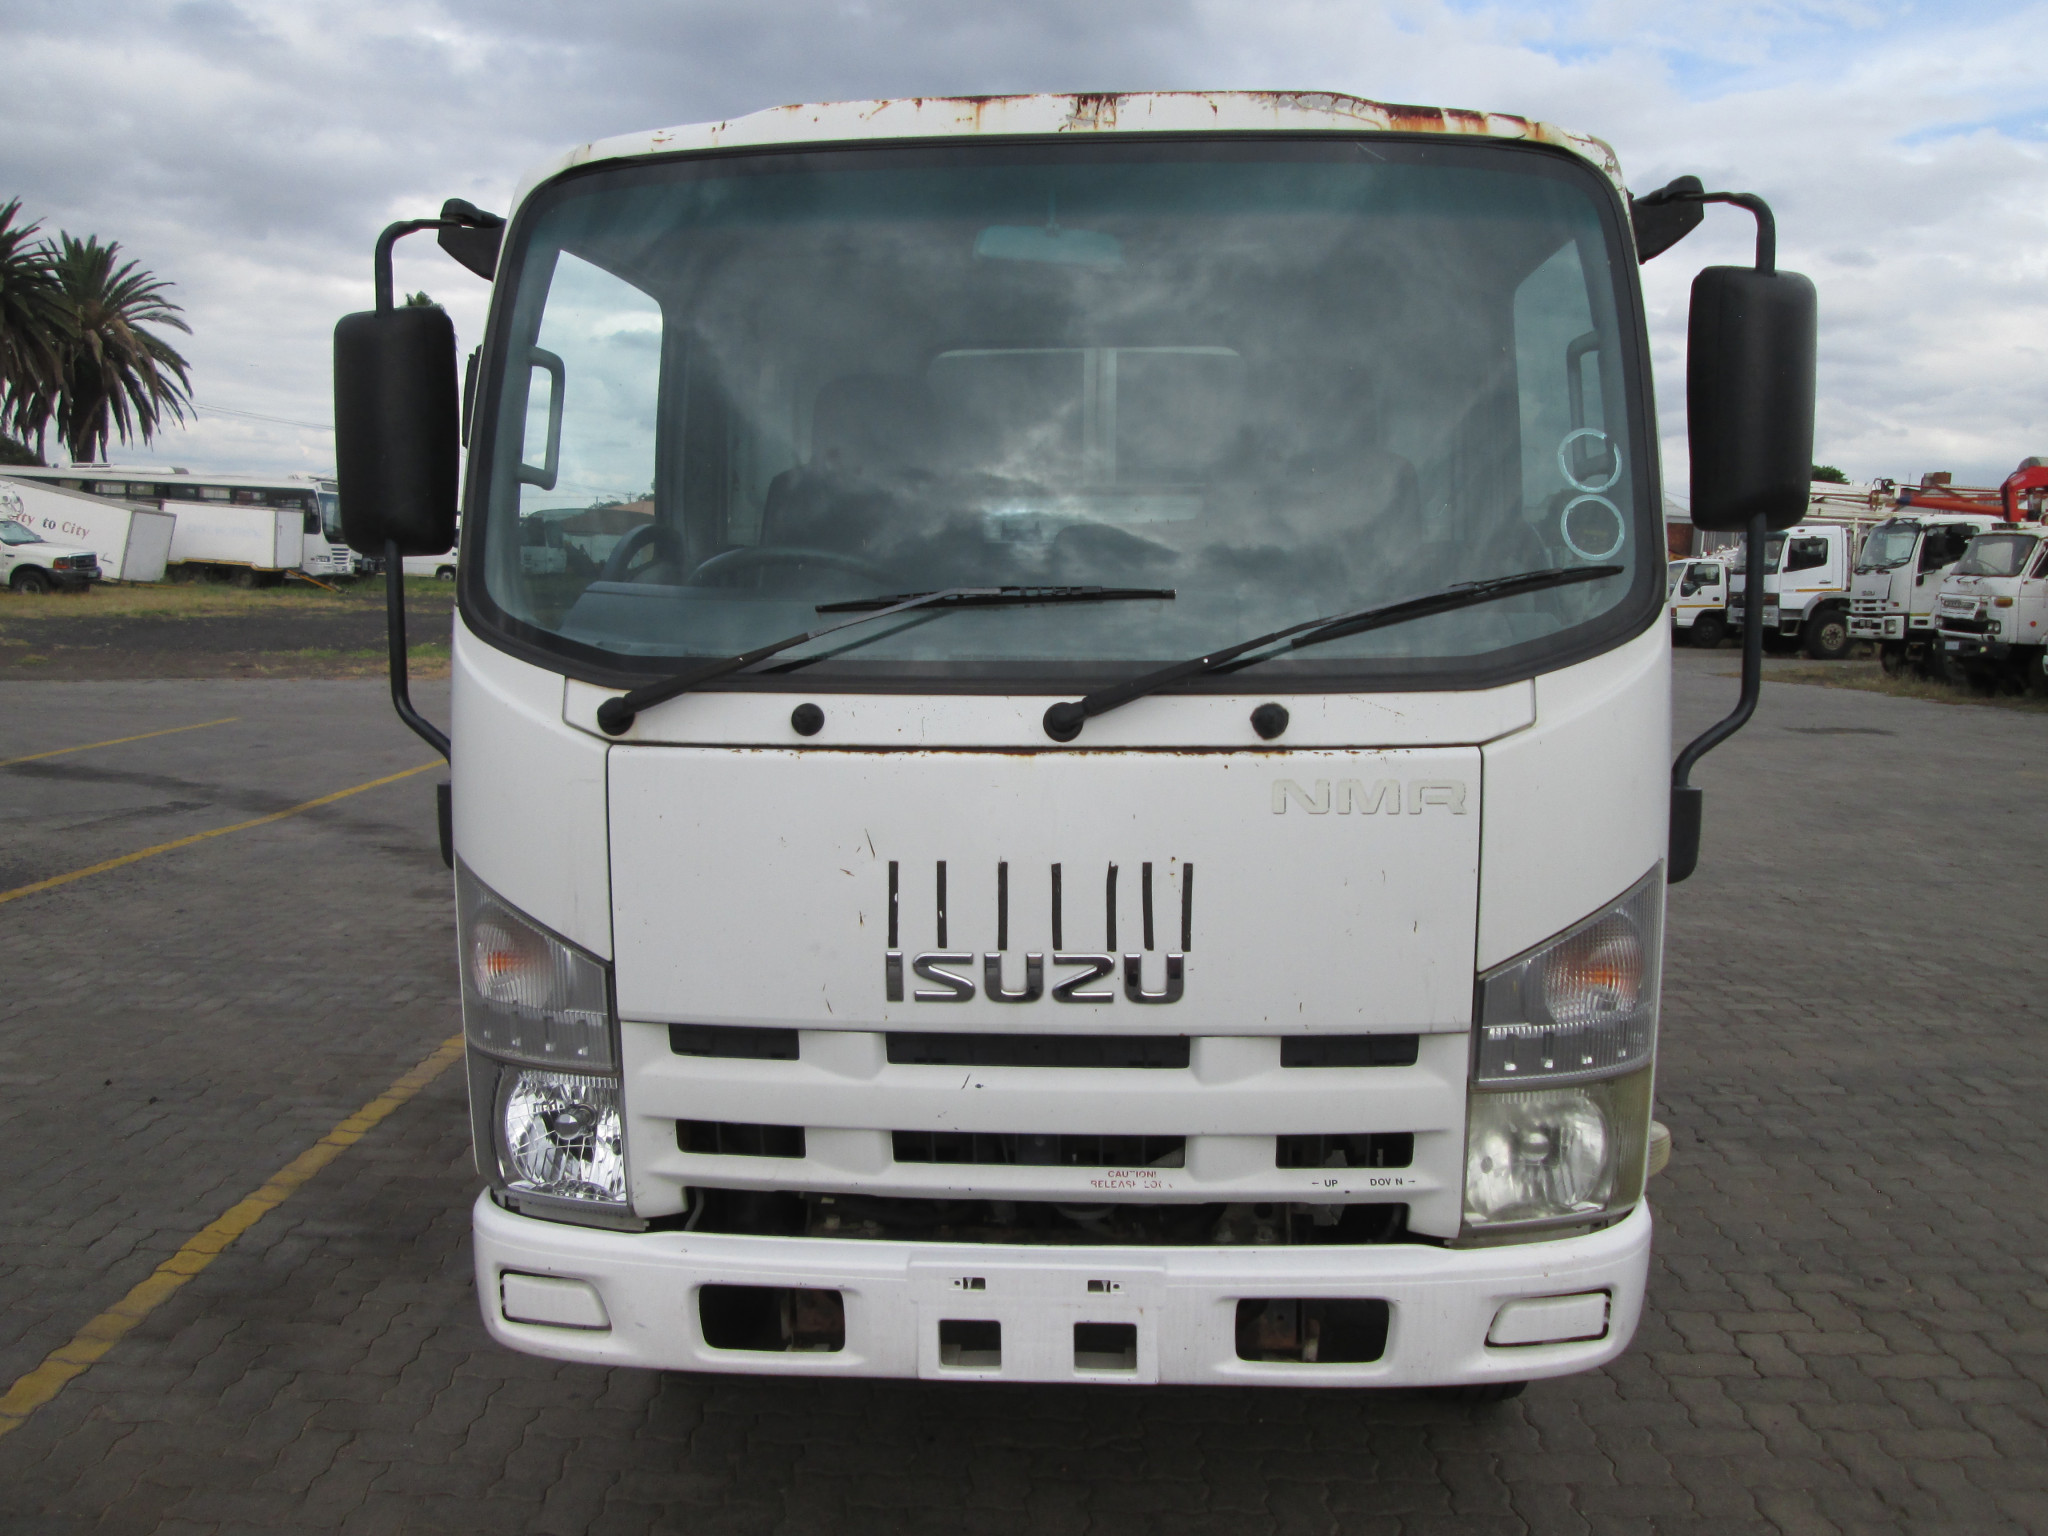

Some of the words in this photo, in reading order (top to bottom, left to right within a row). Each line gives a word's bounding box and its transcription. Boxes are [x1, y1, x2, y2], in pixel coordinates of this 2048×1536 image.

[42, 517, 57, 530] to
[62, 521, 90, 540] City
[1272, 779, 1468, 815] NMR
[886, 951, 1185, 1004] ISUZU
[1324, 1179, 1338, 1188] UP
